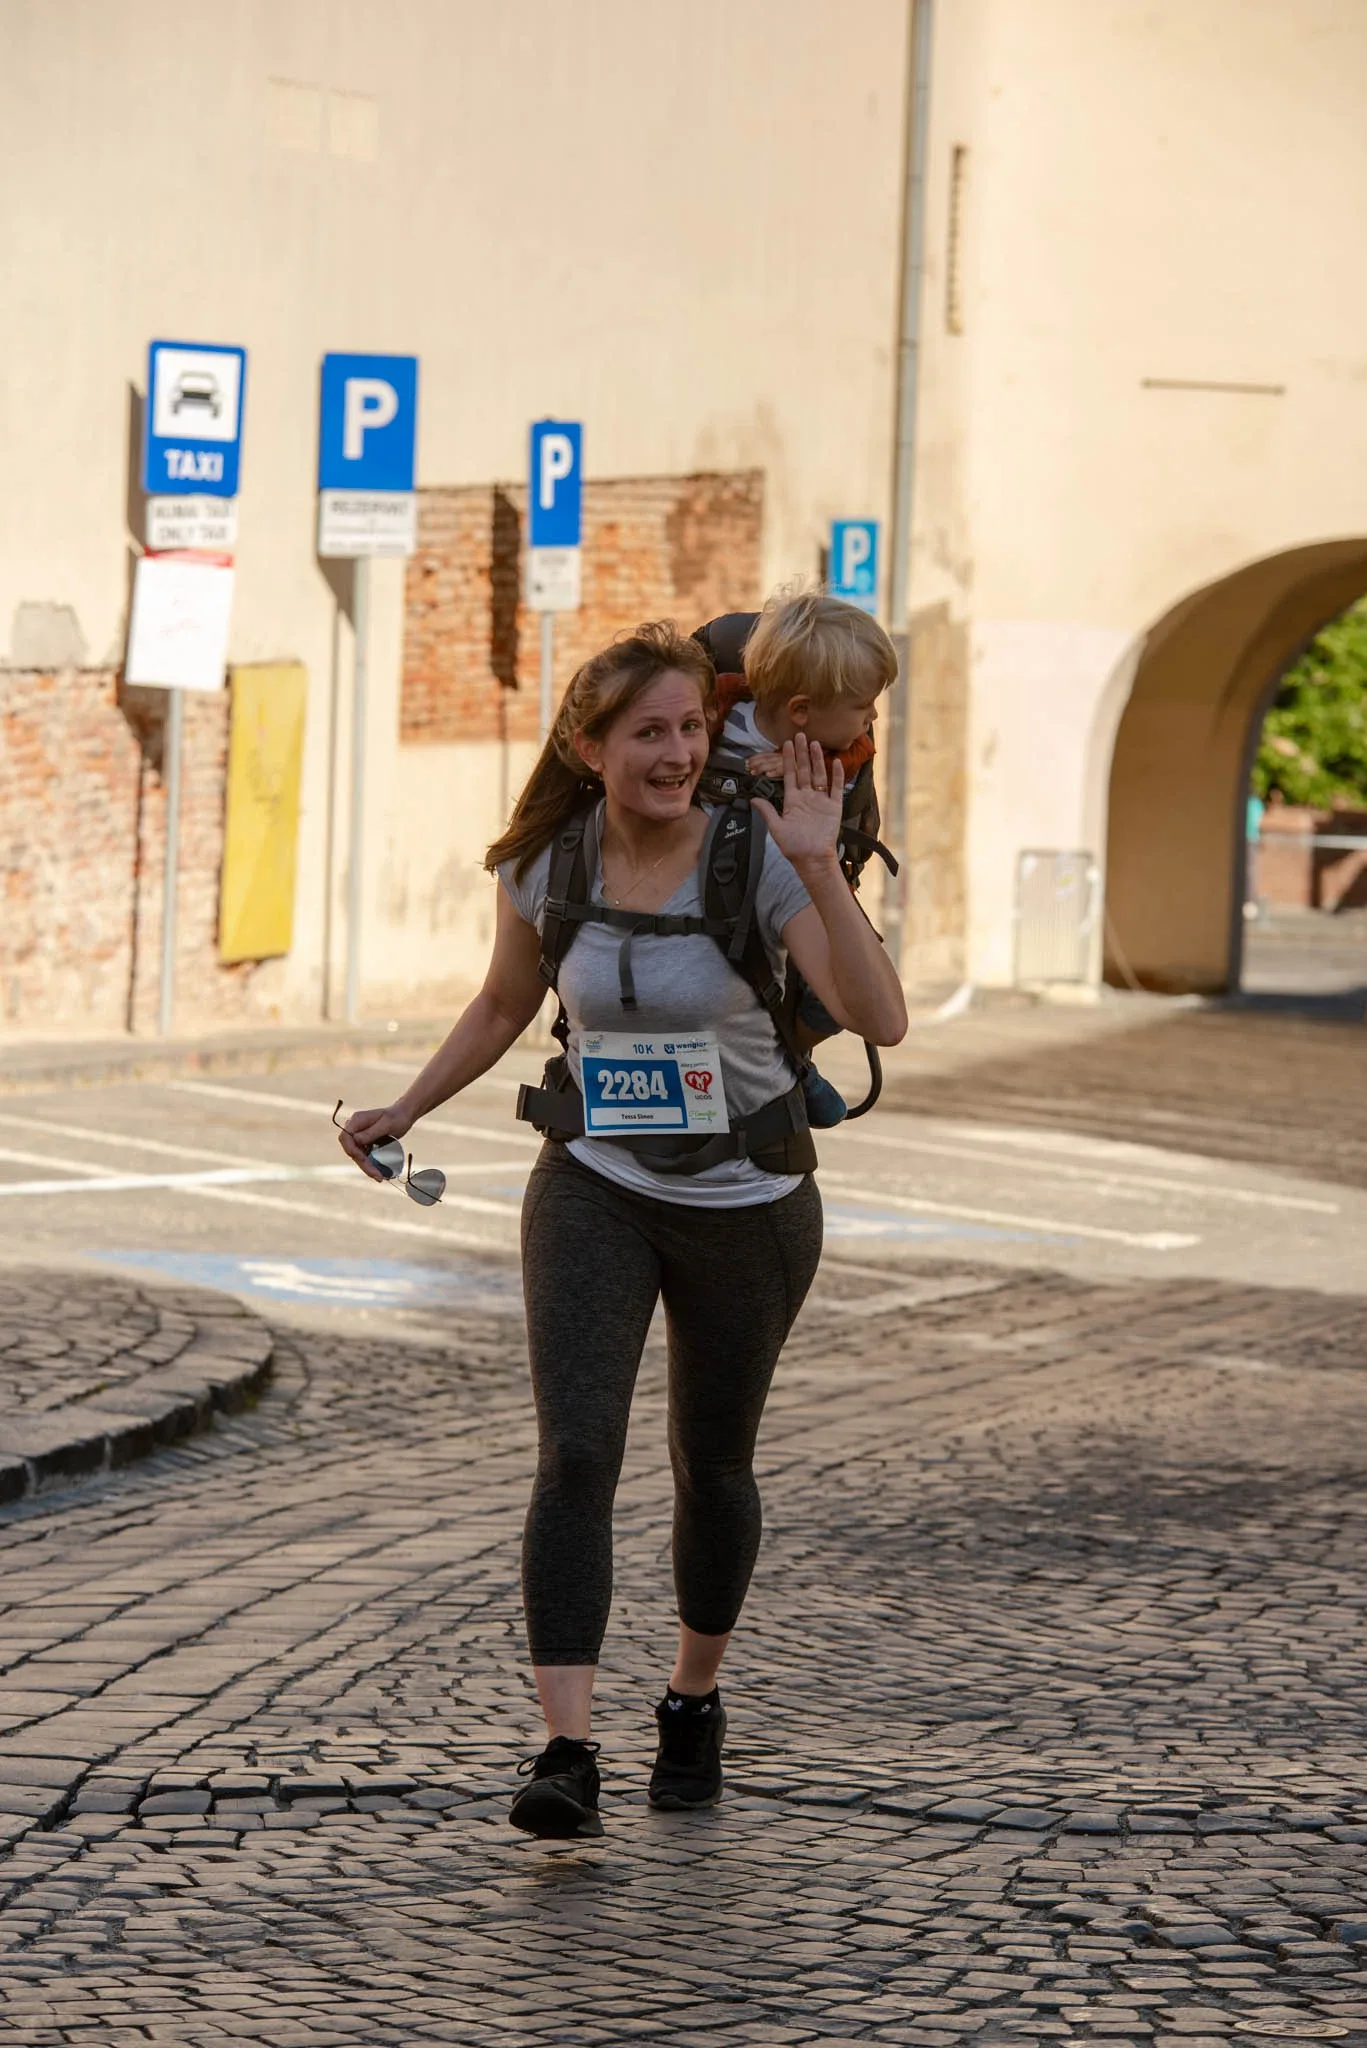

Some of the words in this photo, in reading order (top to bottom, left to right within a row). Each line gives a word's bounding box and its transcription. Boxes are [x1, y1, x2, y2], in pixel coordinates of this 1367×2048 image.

[343, 377, 400, 460] P
[163, 448, 224, 482] TAXI
[539, 433, 574, 510] P
[842, 526, 871, 588] P
[597, 1069, 669, 1101] 2284
